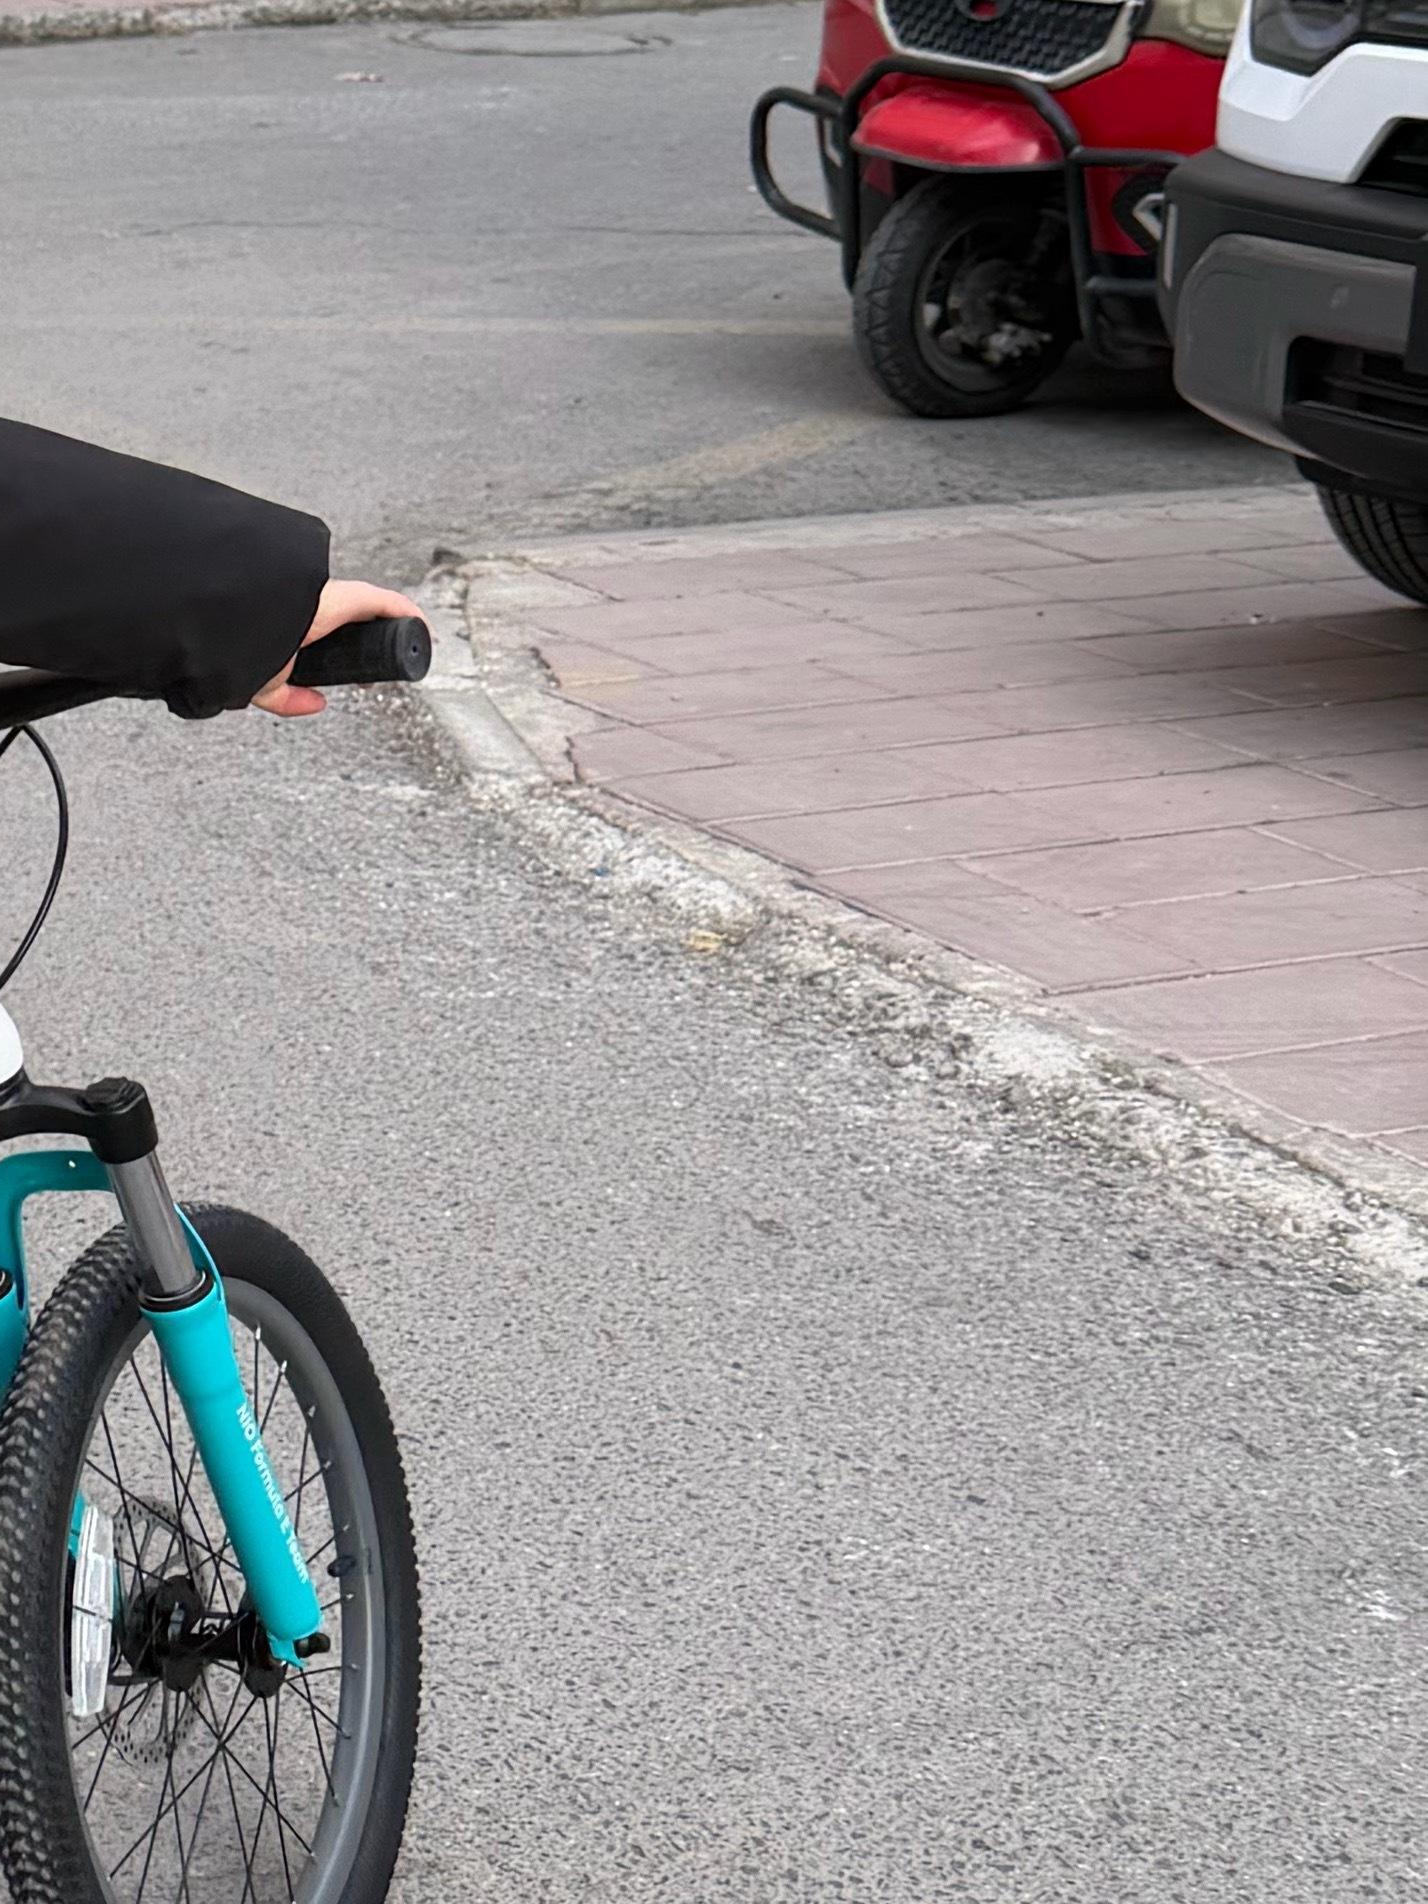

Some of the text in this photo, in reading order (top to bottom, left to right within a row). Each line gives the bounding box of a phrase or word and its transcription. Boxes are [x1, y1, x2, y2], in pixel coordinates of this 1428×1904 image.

[236, 1402, 310, 1585] NIO Formula E Team
